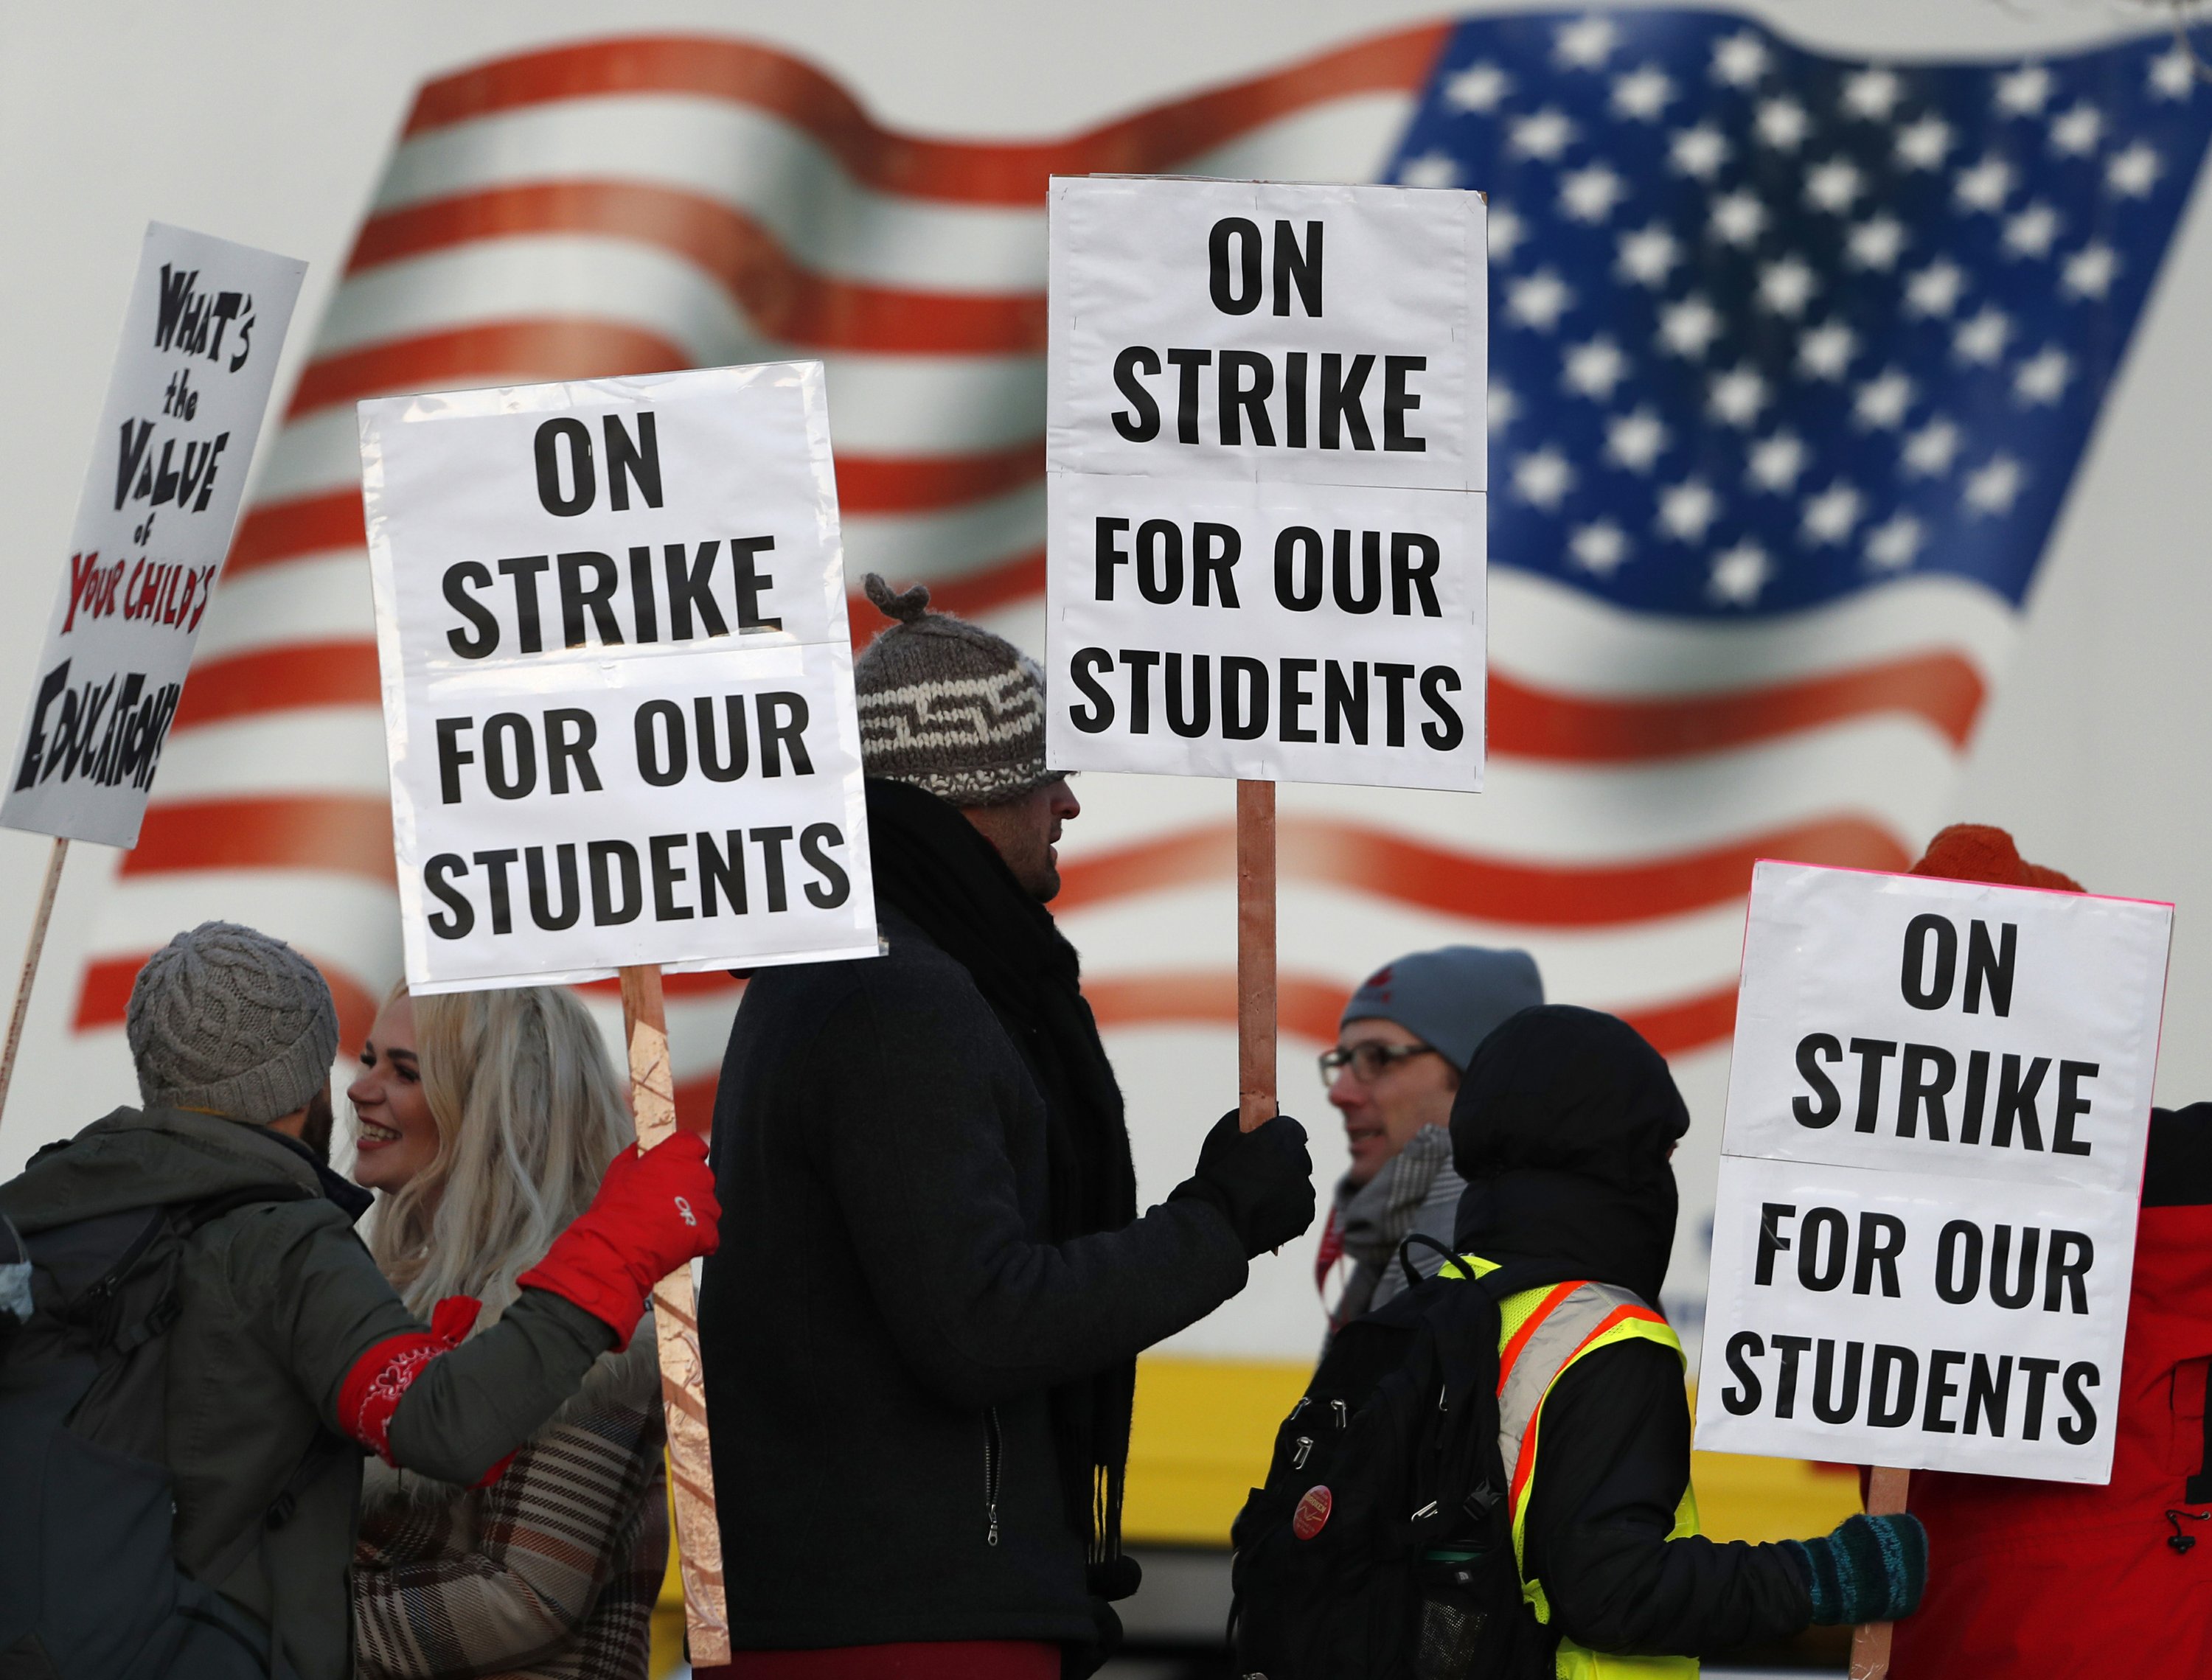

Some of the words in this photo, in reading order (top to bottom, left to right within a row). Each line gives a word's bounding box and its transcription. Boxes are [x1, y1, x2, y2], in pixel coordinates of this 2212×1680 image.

[154, 262, 257, 373] WHAT'S
[1208, 217, 1324, 318] ON
[162, 369, 198, 422] the
[1110, 346, 1427, 453] STRIKE
[114, 416, 231, 514] VALUE
[534, 411, 664, 517] ON
[133, 512, 156, 547] of
[1095, 516, 1242, 609] FOR
[1274, 526, 1443, 618] OUR
[60, 551, 125, 635] YOUR
[123, 555, 216, 635] CHILD'S
[442, 535, 783, 660] STRIKE
[436, 708, 603, 804] FOR
[634, 691, 815, 787] OUR
[1069, 646, 1464, 751] STUDENTS
[423, 822, 851, 941] STUDENTS
[1901, 913, 2017, 1018] ON
[1792, 1033, 2100, 1157] STRIKE
[1754, 1202, 1906, 1298] FOR
[1935, 1219, 2094, 1315] OUR
[1721, 1331, 2100, 1446] STUDENTS
